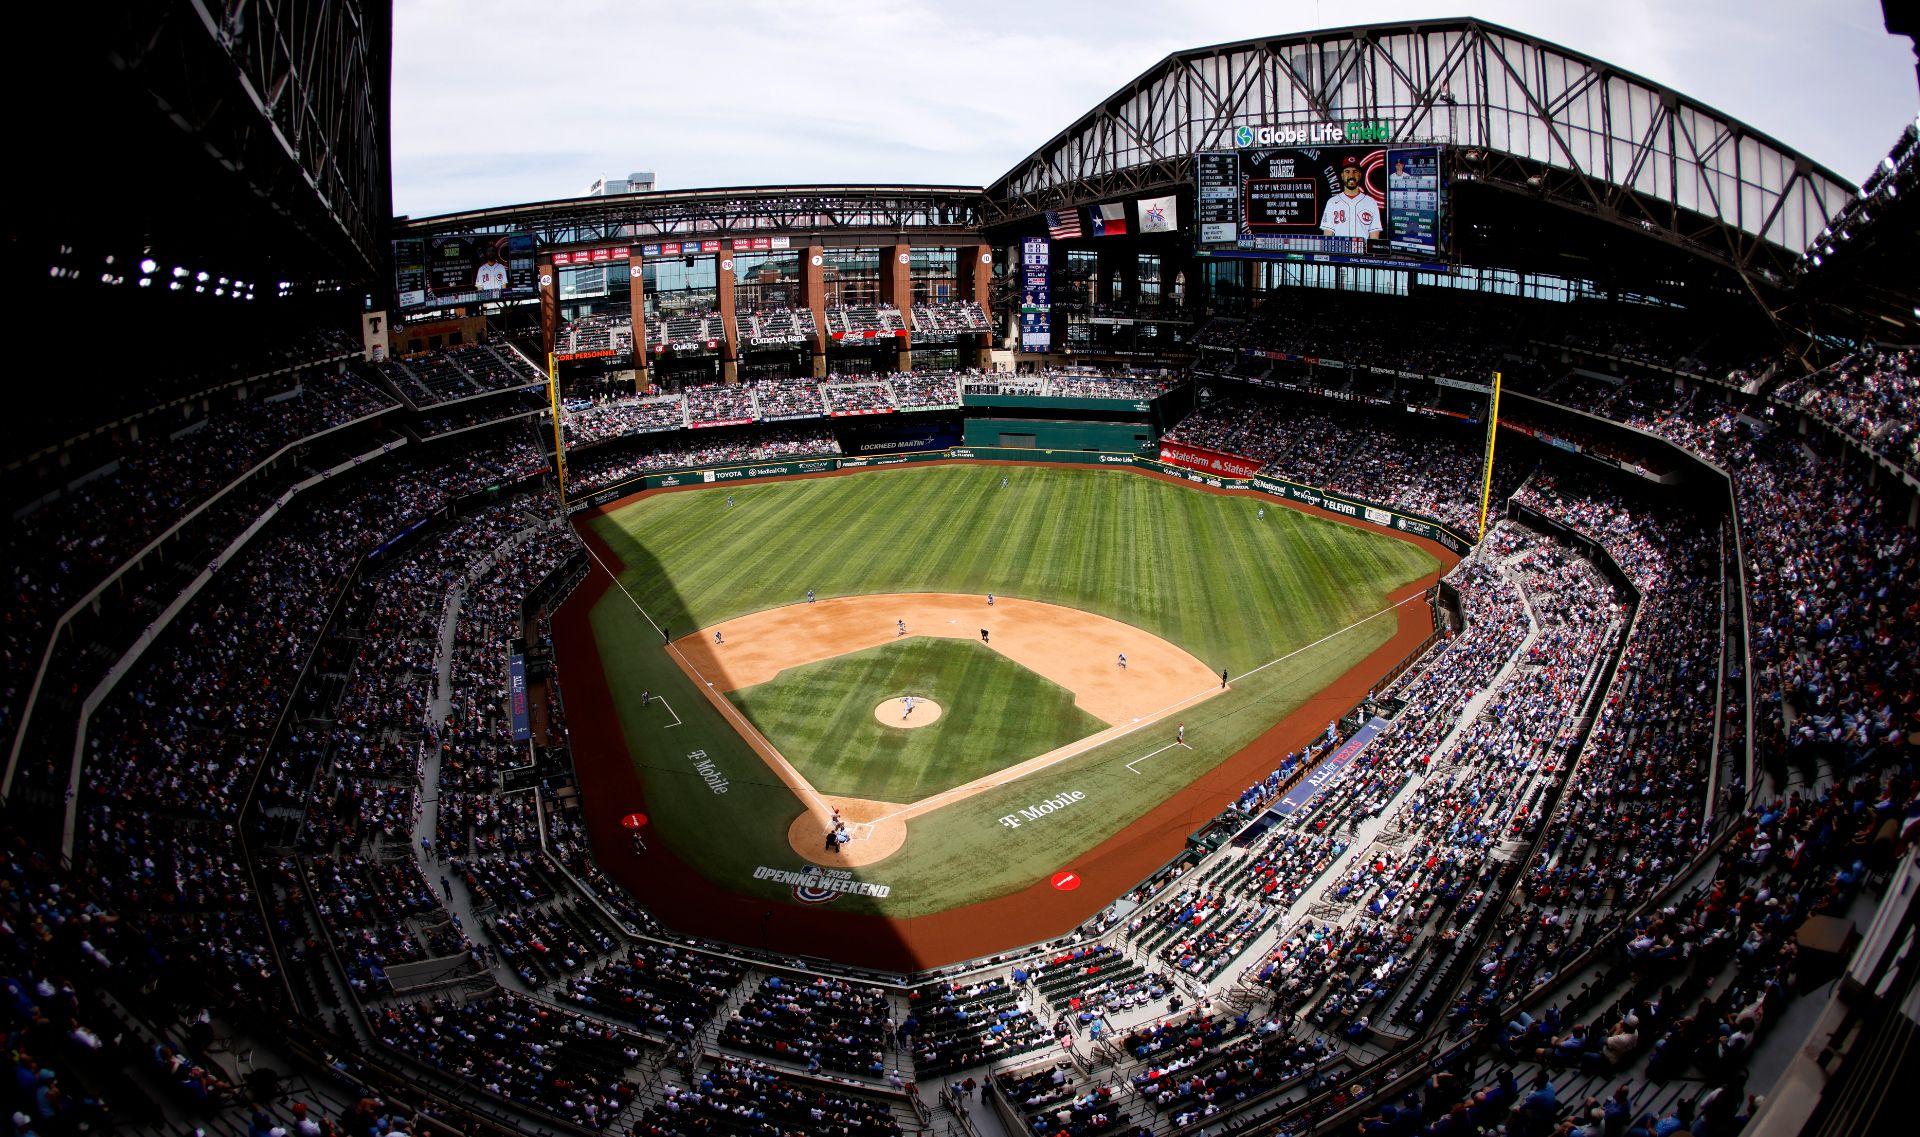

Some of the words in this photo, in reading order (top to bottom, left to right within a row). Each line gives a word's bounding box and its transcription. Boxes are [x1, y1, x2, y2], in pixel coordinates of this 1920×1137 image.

[1258, 127, 1307, 144] Globe
[1310, 122, 1343, 142] Life
[1346, 120, 1388, 141] Field
[1333, 210, 1345, 224] 28
[369, 317, 381, 334] T
[788, 334, 807, 342] Bank
[843, 332, 864, 340] Coca-Cola
[673, 342, 699, 351] QuikTrip
[575, 350, 616, 360] PERSONNEL
[1260, 481, 1286, 493] National
[1301, 490, 1321, 505] Kroger
[1441, 533, 1459, 551] Mobile
[687, 749, 707, 760] T
[1308, 768, 1331, 786] ALL
[1325, 762, 1338, 775] for
[1333, 740, 1362, 765] TEXAS
[693, 758, 729, 794] Mobile
[998, 814, 1021, 828] T
[1018, 791, 1085, 821] Mobile
[1282, 798, 1297, 807] T
[826, 869, 852, 880] 2026
[752, 866, 818, 888] OPENING
[818, 875, 890, 898] WEEKEND
